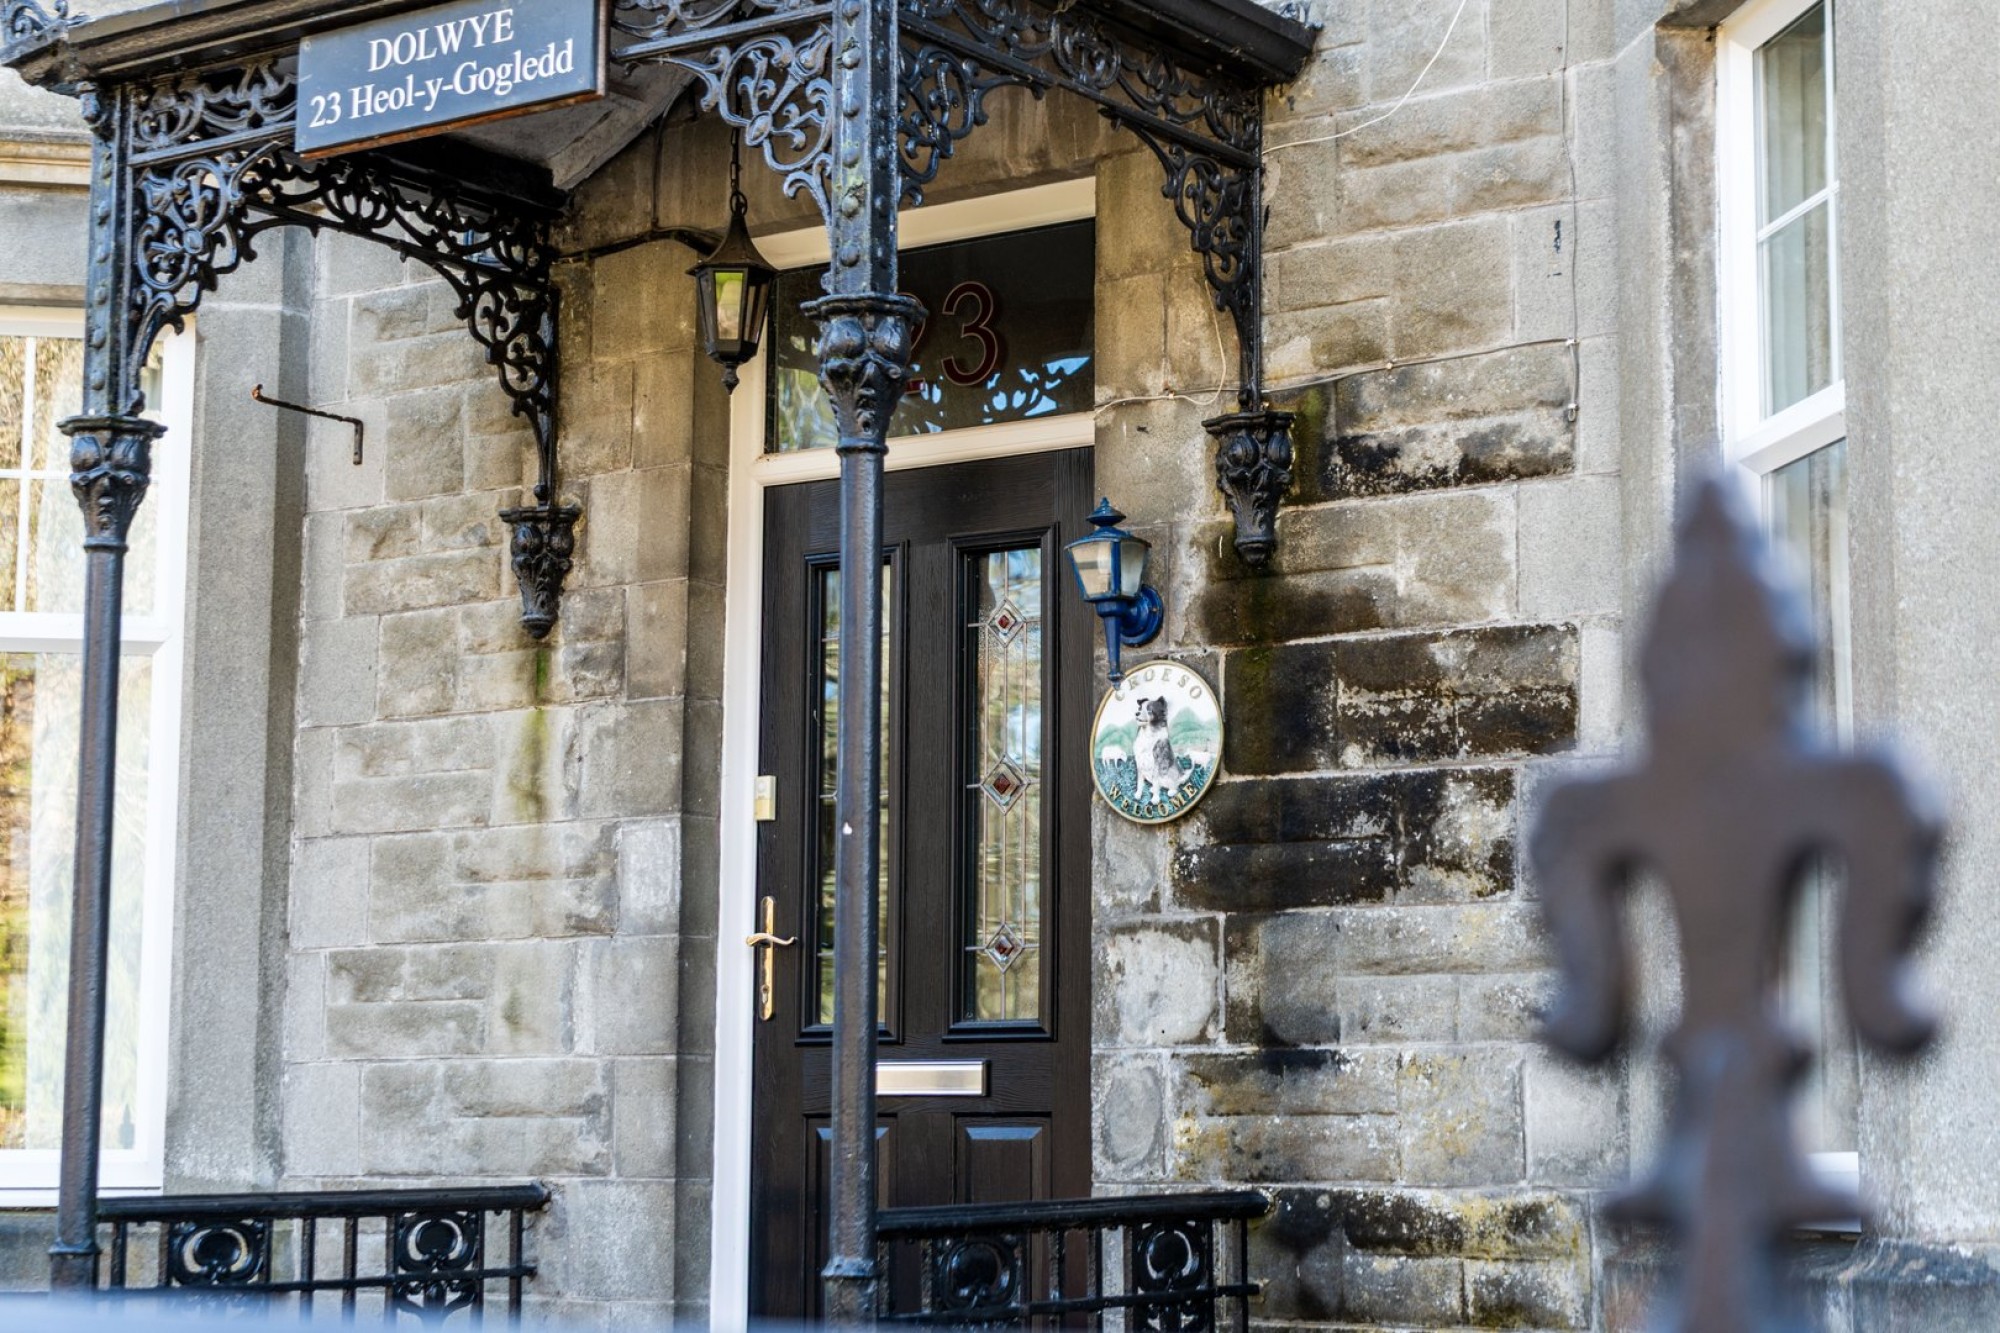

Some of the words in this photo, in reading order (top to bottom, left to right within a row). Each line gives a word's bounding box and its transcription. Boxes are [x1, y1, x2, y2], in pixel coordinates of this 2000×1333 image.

[368, 8, 514, 72] DOLWYE
[308, 91, 342, 128] 23
[348, 38, 574, 119] Heol-y-Gogledd
[1109, 782, 1198, 818] WELCOME
